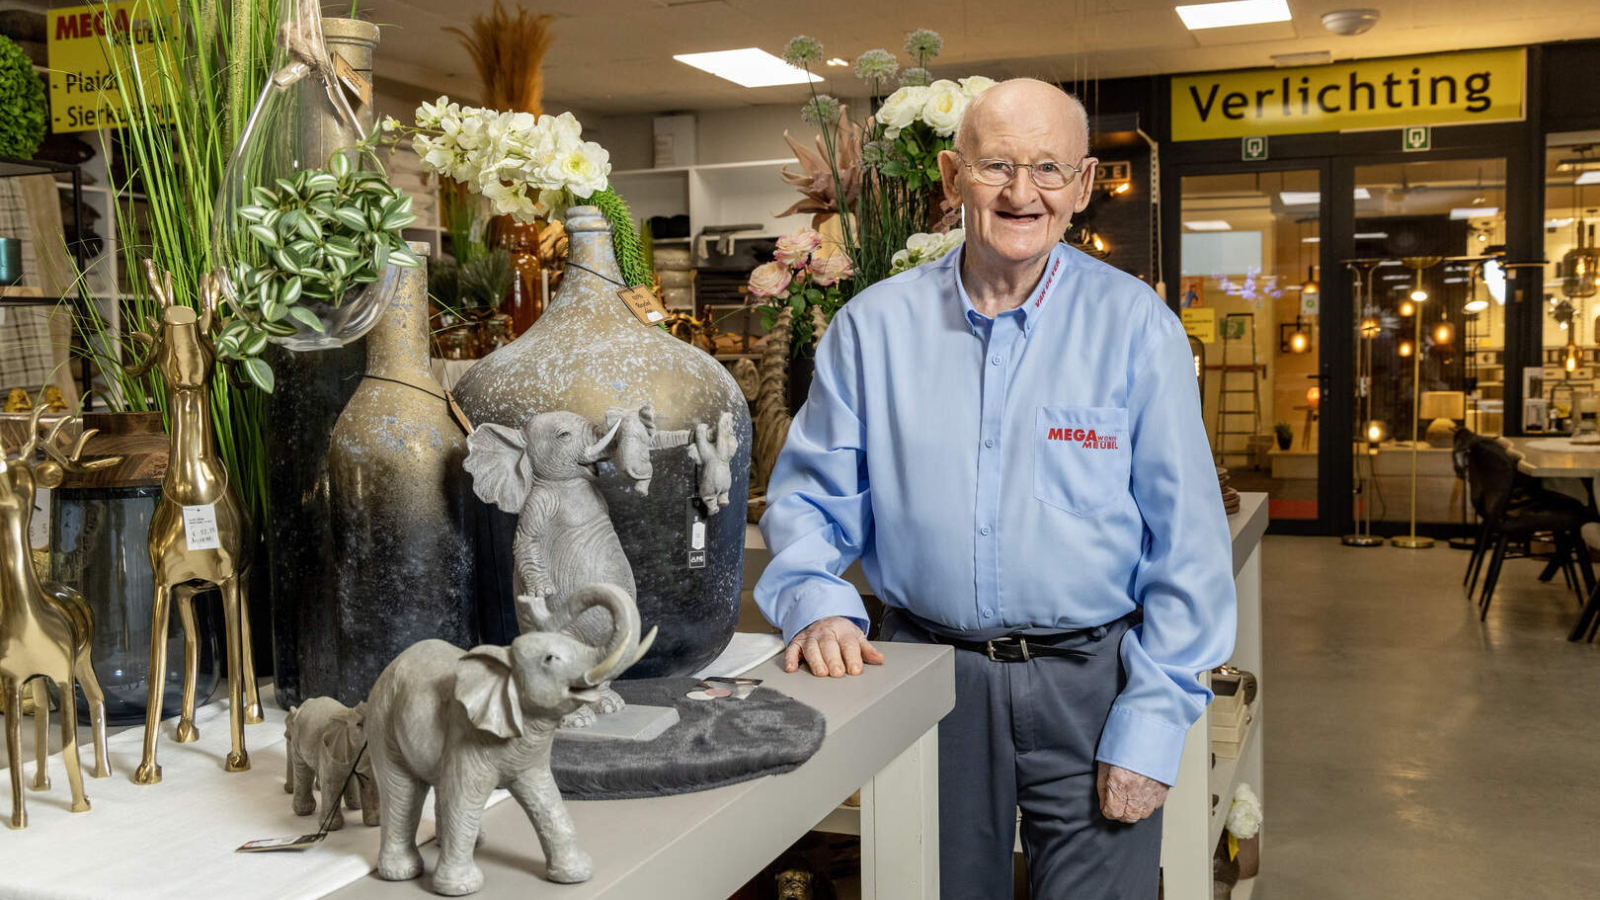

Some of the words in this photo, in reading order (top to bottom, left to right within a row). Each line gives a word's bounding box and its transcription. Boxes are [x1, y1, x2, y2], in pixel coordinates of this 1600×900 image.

[56, 9, 130, 40] MEGA
[112, 27, 178, 46] MEUBE
[1188, 67, 1492, 123] Verlichting
[1035, 288, 1046, 308] VAN
[1045, 277, 1052, 290] DE
[1047, 428, 1098, 442] MEGA
[1082, 441, 1119, 450] MEUBEL
